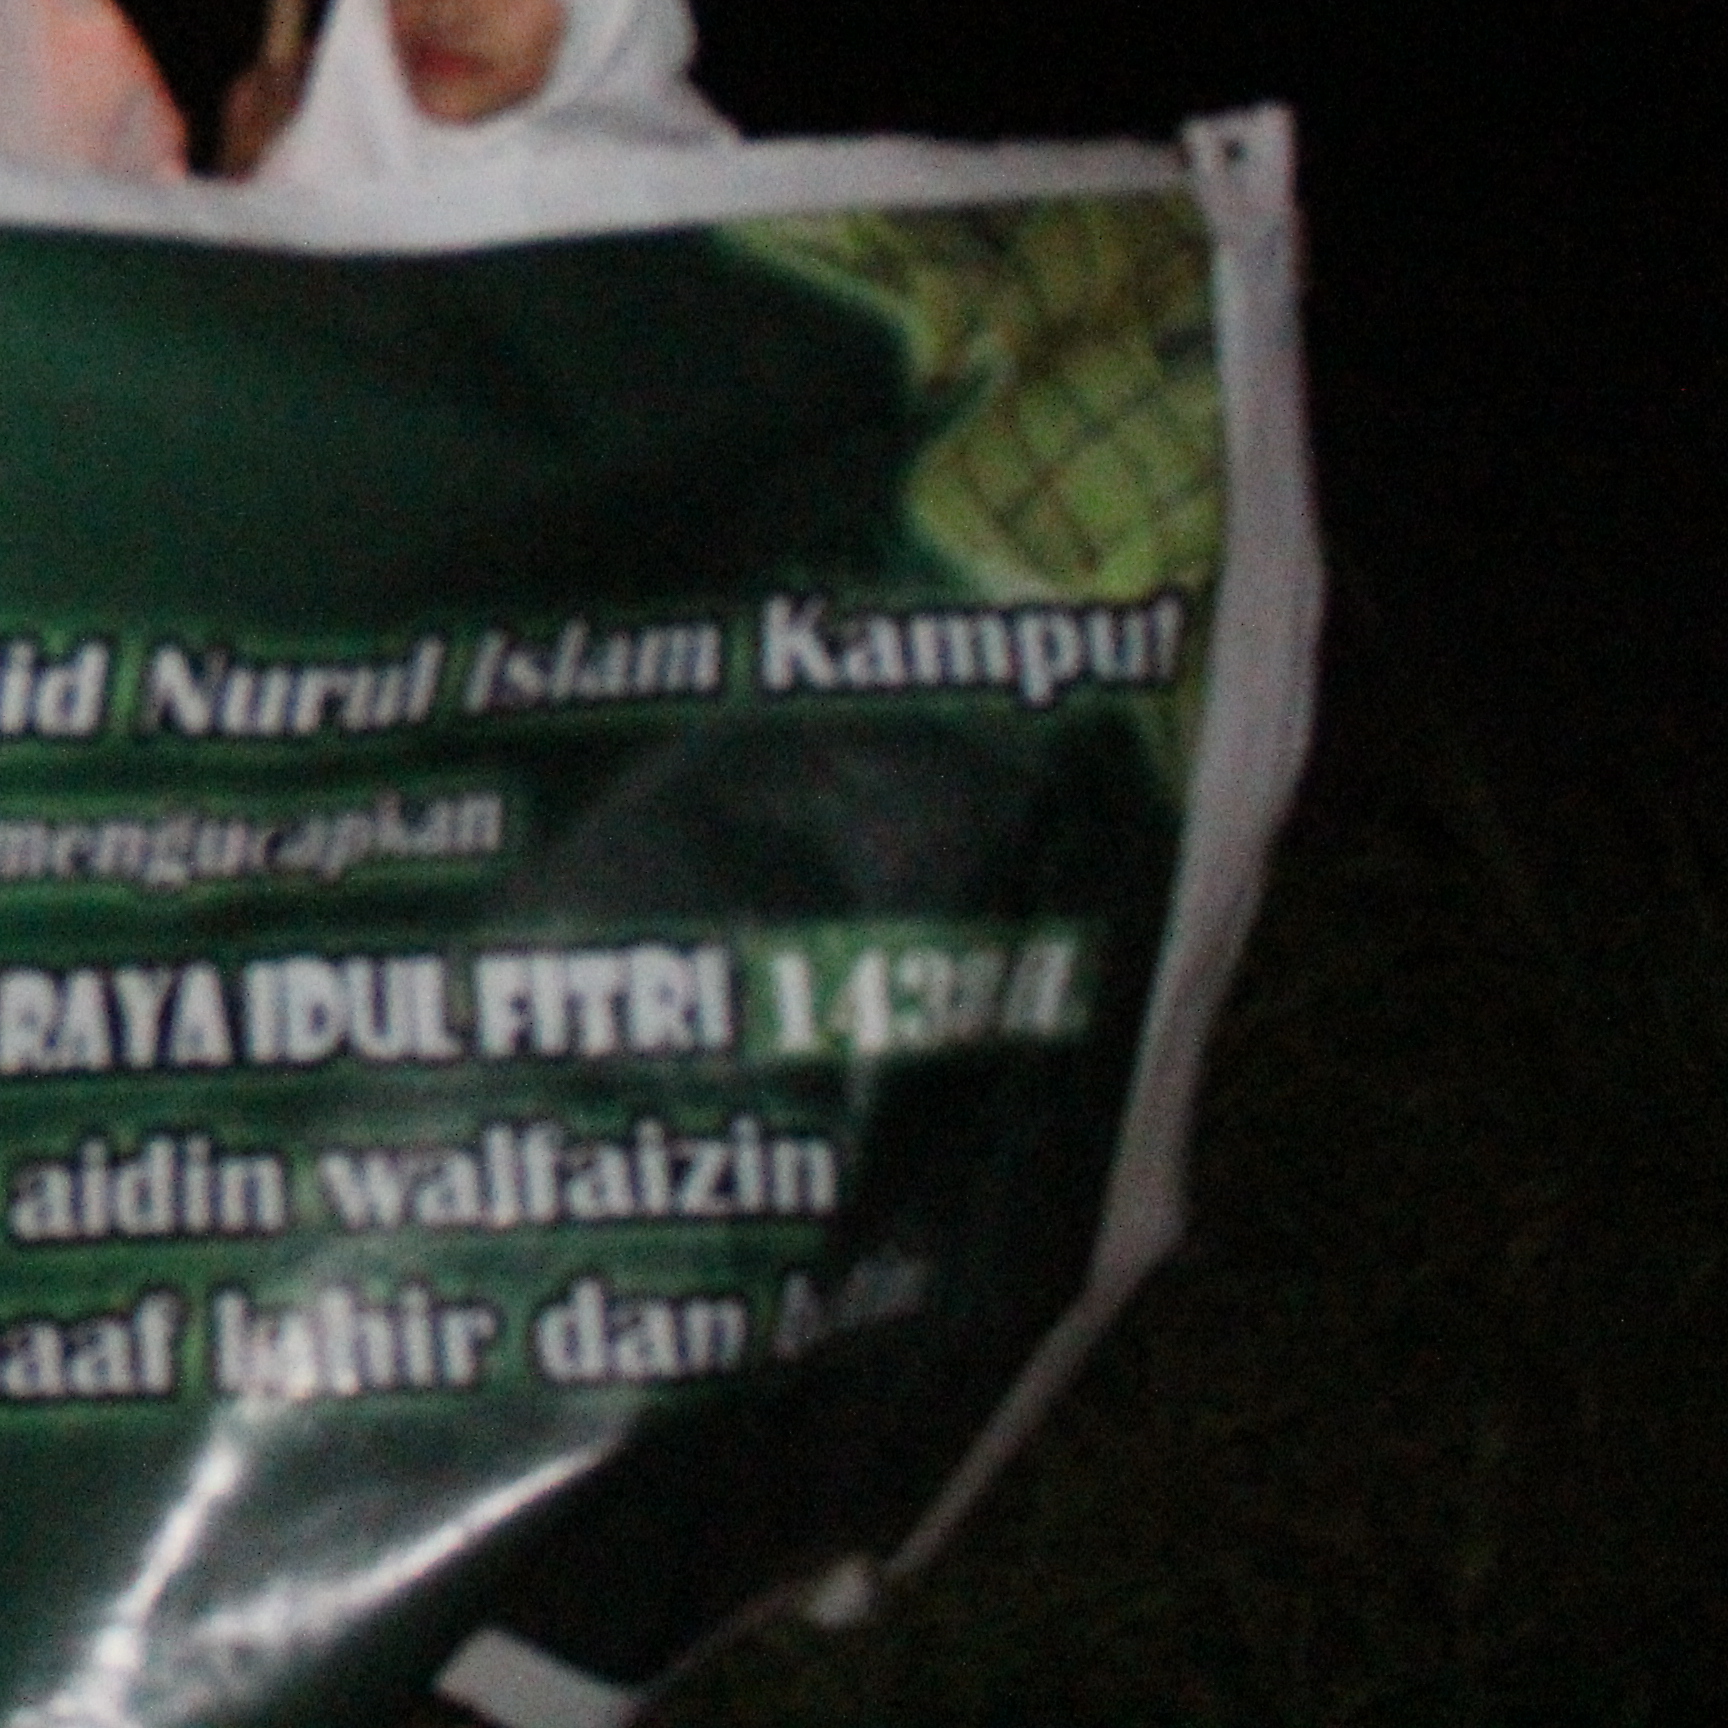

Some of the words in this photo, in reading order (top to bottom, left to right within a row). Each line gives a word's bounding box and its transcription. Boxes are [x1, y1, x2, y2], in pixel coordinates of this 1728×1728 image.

[147, 637, 442, 736] Nurul
[464, 614, 721, 713] Islam
[241, 953, 465, 1065] IDUL
[472, 942, 734, 1062] FITRI
[7, 1134, 287, 1245] aidin
[318, 1117, 838, 1230] walfaizin
[211, 1281, 498, 1398] lahir
[533, 1275, 746, 1384] dan
